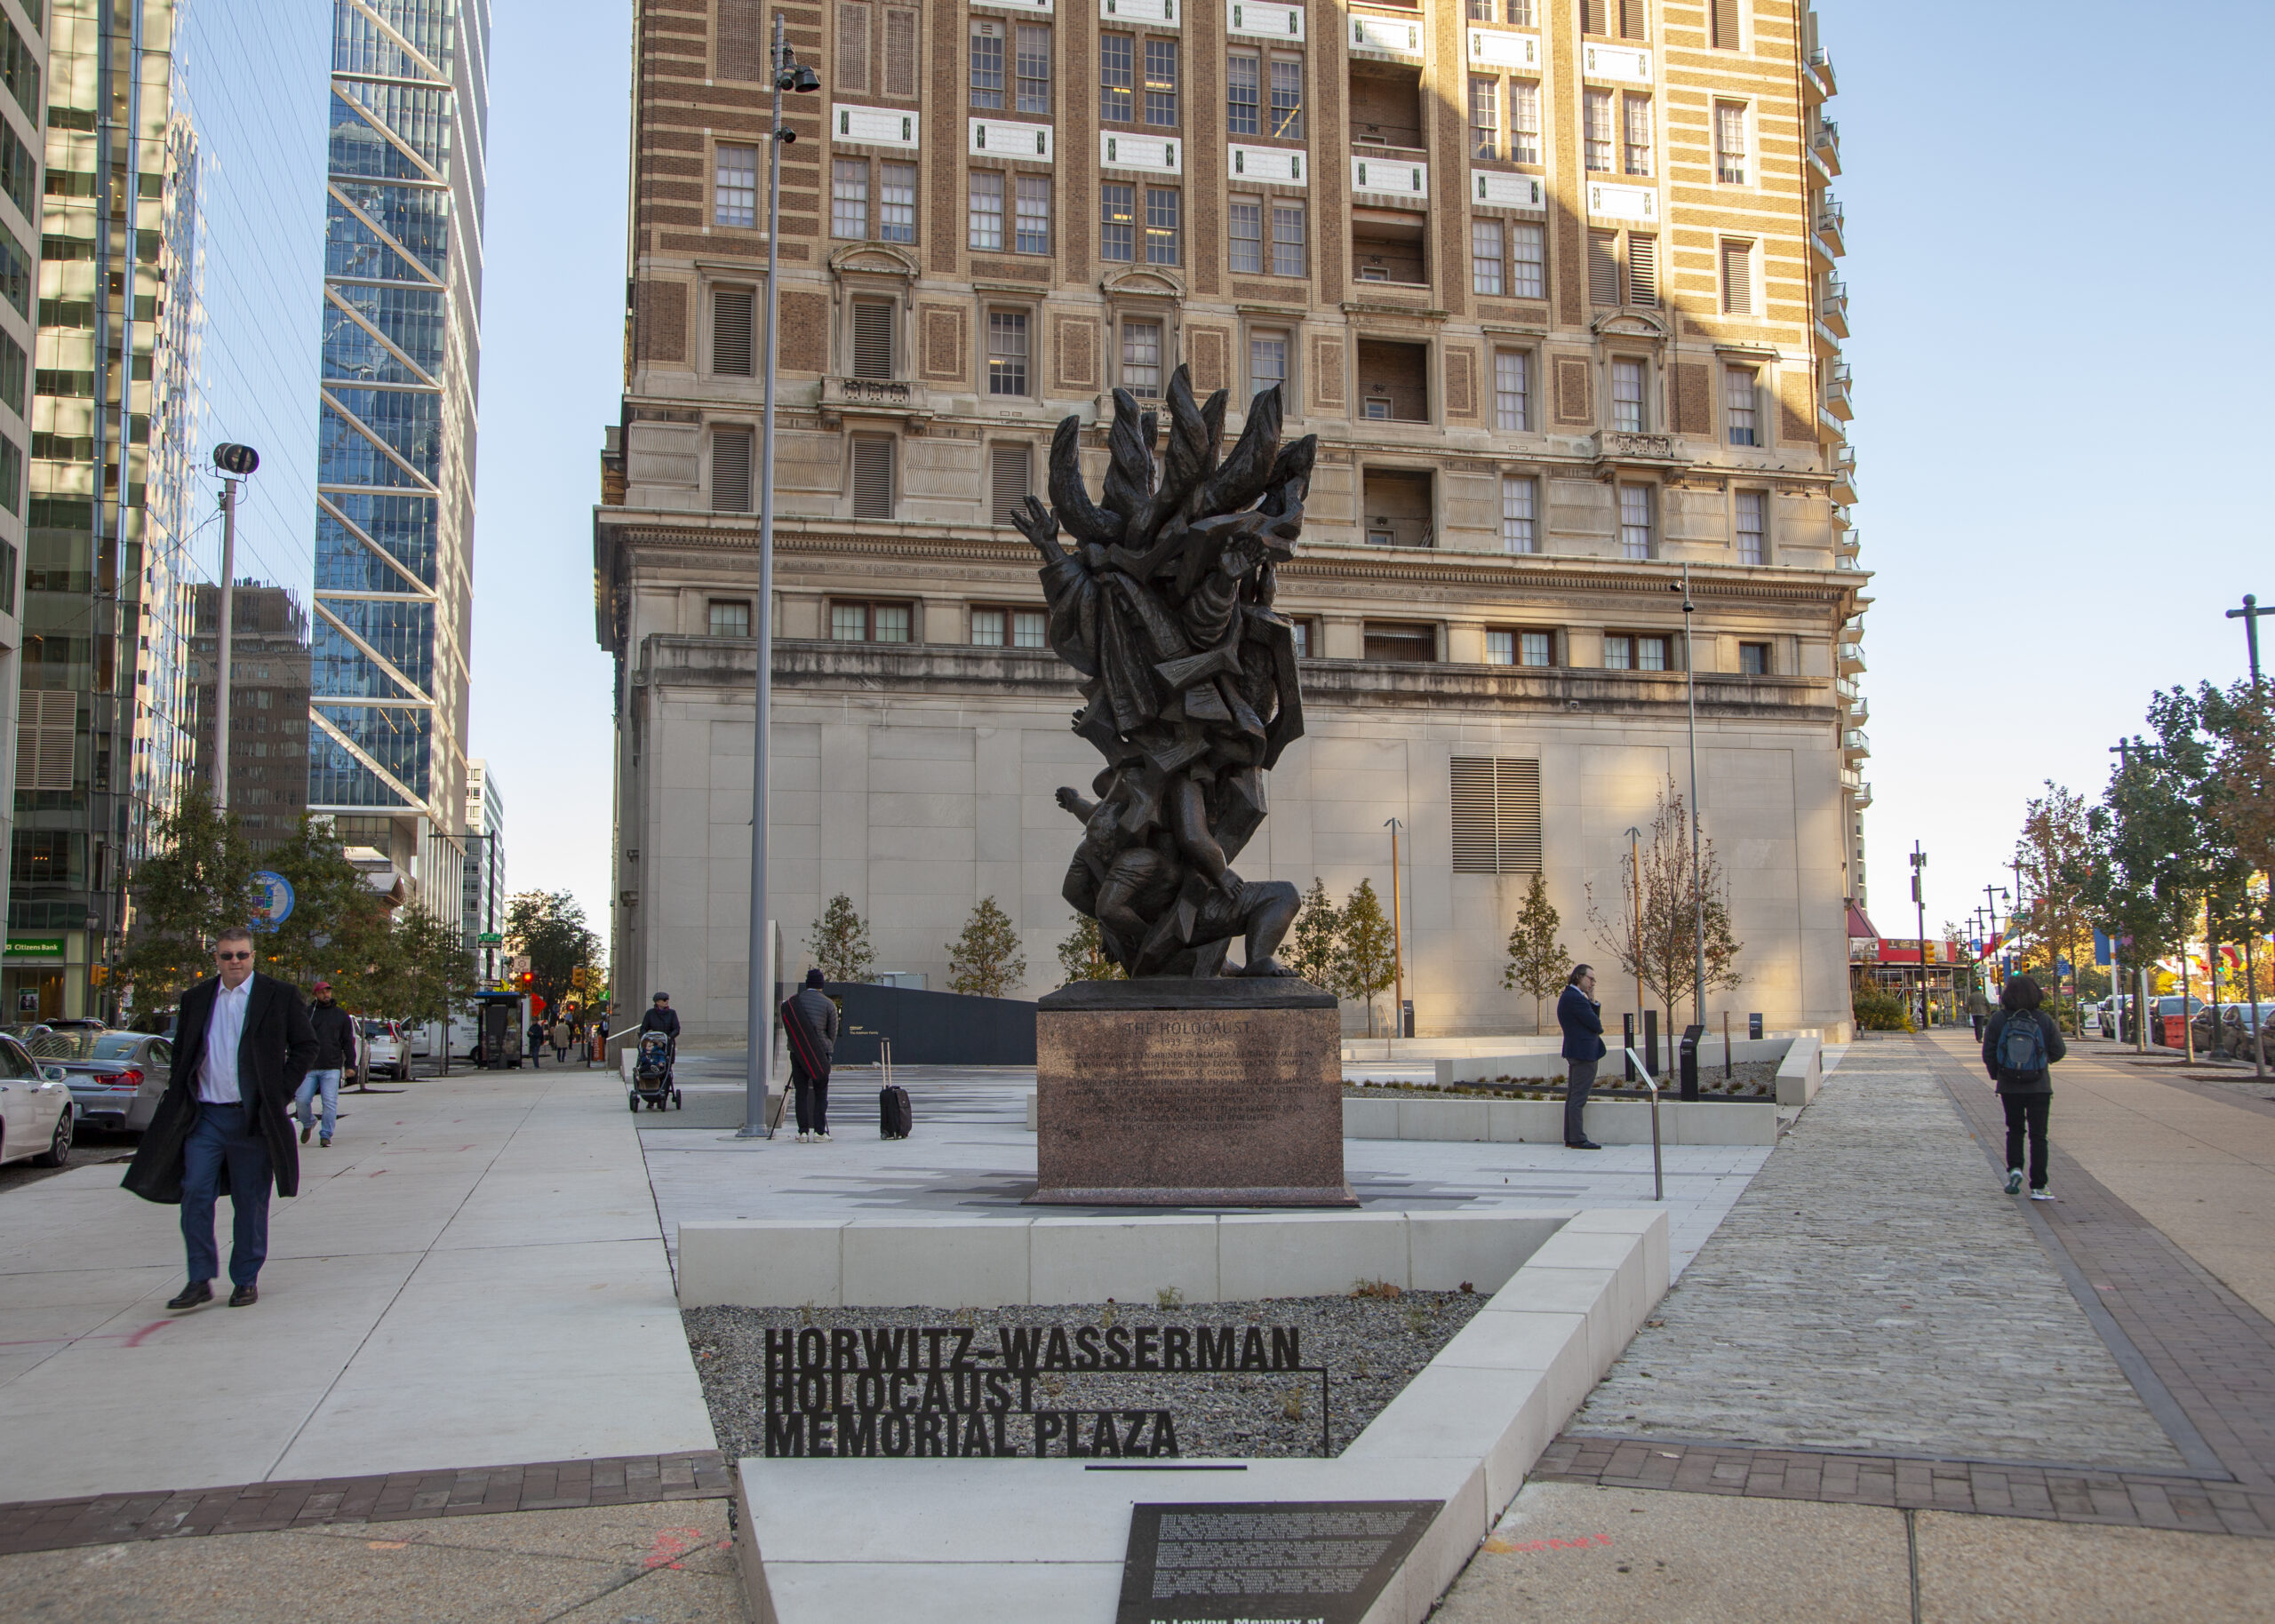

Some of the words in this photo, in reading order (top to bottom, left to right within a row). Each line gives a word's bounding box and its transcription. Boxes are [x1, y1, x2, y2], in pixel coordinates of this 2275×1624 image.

[1125, 1022, 1153, 1036] THE
[1160, 1021, 1252, 1036] HOLOCAUST
[1161, 1038, 1182, 1047] 1933
[765, 1326, 1300, 1372] HORWITZ-WASSERMAN
[765, 1370, 1038, 1414] HOLOCAUST
[765, 1413, 1018, 1458] MEMORIAL
[1034, 1412, 1179, 1458] PLAZA
